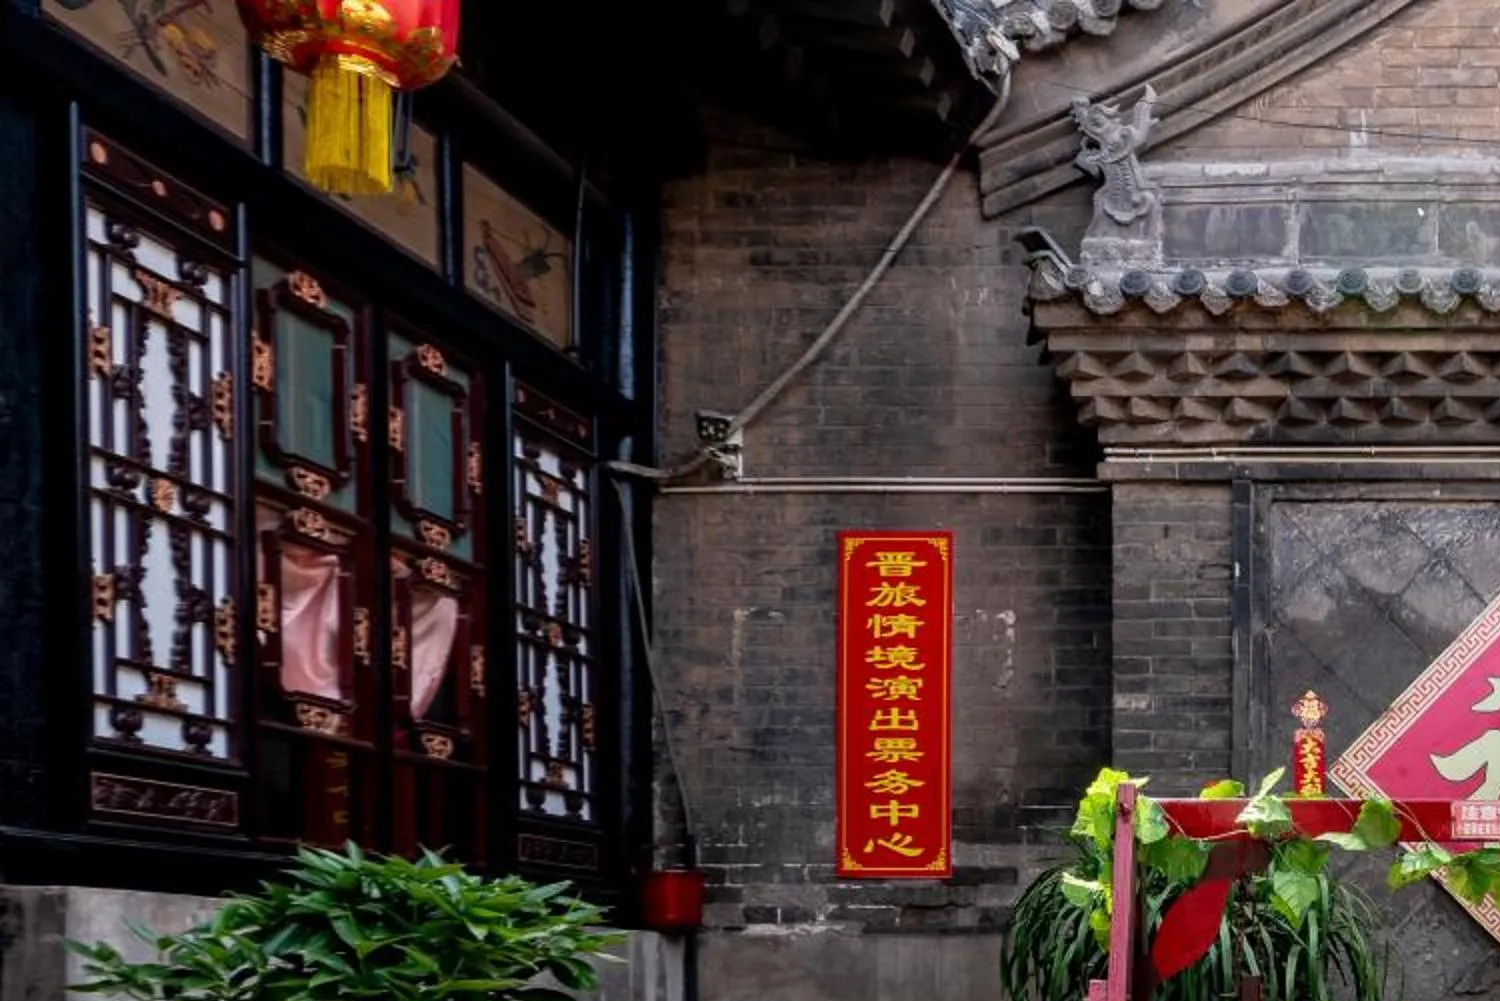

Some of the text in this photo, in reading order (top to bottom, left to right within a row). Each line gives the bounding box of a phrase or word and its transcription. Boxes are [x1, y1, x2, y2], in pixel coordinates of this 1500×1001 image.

[864, 551, 928, 858] 晋旅情境演出票务中心
